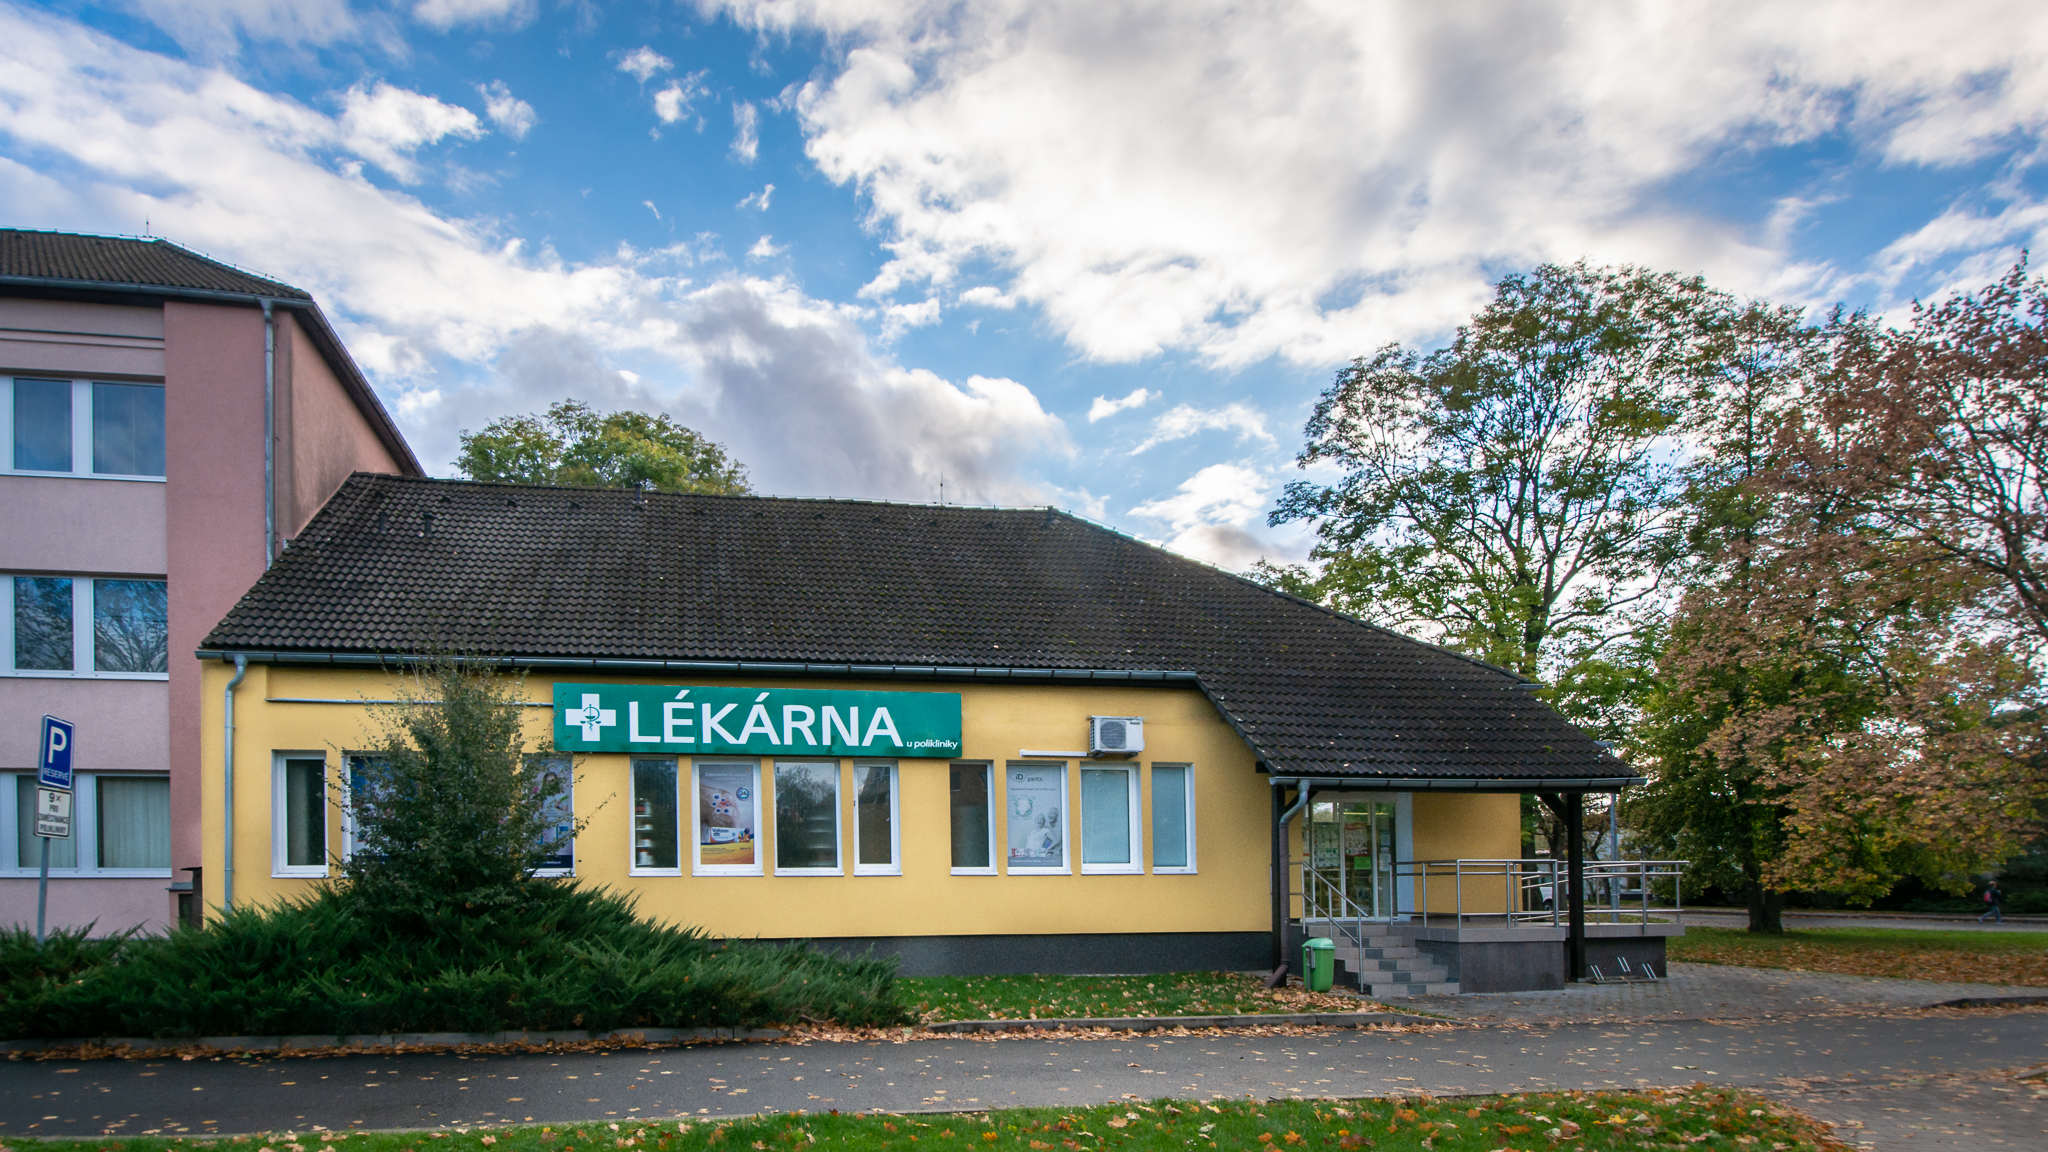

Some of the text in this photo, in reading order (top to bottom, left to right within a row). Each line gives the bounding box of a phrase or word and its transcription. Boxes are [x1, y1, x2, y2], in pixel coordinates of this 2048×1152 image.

[629, 689, 904, 748] LÉKÁRNA
[48, 726, 67, 764] P
[914, 739, 958, 750] polikliniky
[1015, 773, 1024, 781] iD
